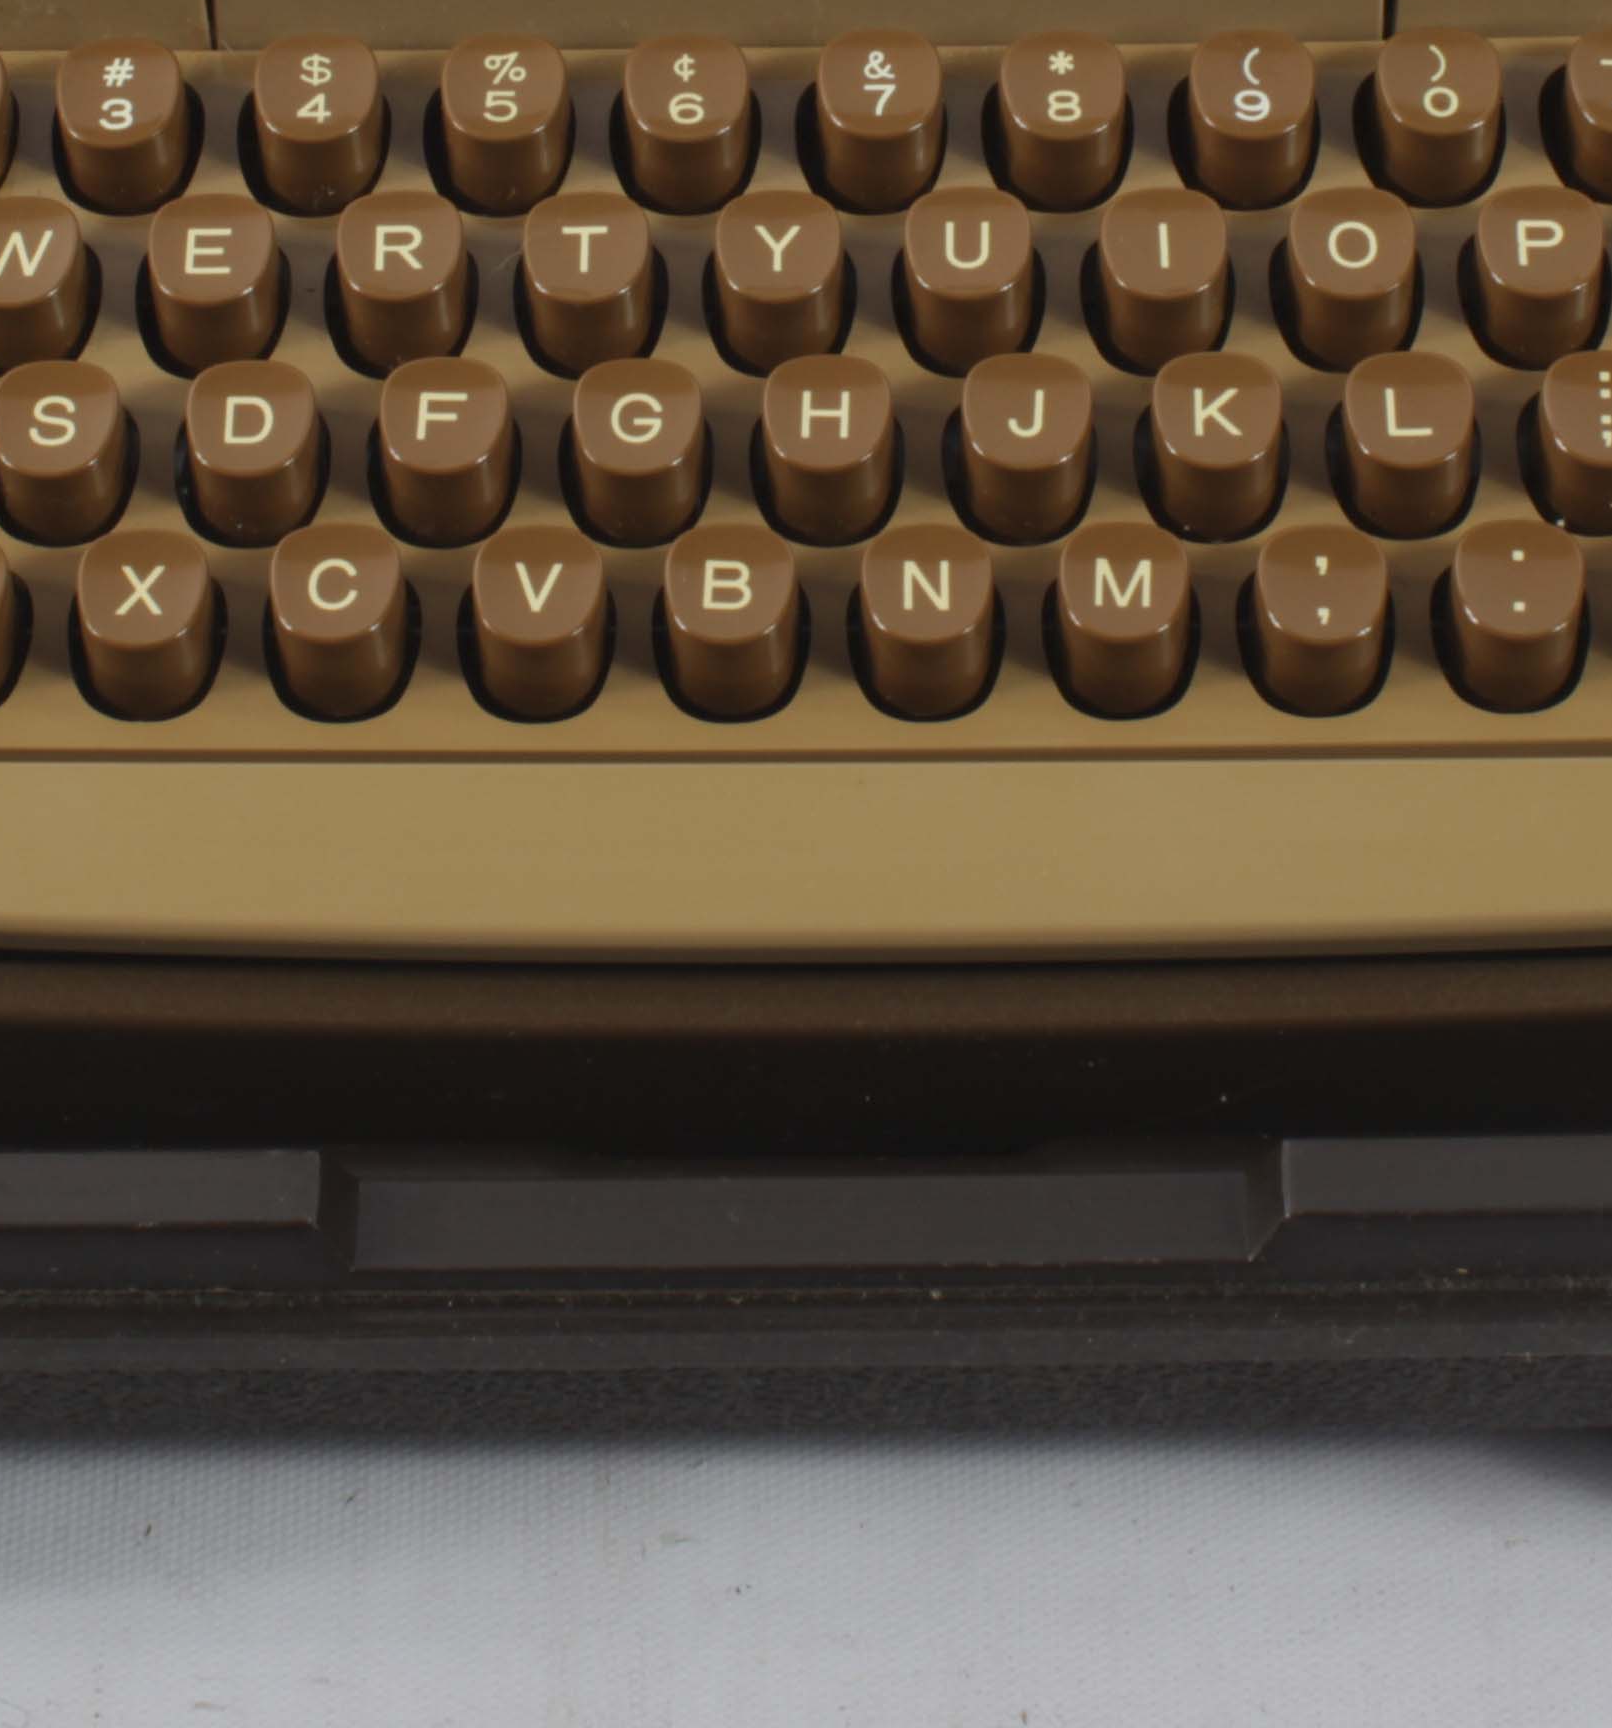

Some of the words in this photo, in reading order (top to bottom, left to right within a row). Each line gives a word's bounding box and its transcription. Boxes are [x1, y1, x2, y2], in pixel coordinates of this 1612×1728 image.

[103, 58, 134, 87] #
[301, 54, 331, 85] $
[484, 52, 526, 83] %
[863, 50, 895, 79] &
[99, 99, 133, 130] 3
[297, 94, 331, 123] 4
[484, 92, 518, 122] 5
[668, 94, 705, 124] 6
[864, 85, 896, 116] 7
[1048, 91, 1081, 122] 8
[1235, 90, 1270, 121] 9
[185, 228, 233, 274] E
[373, 225, 423, 271] R
[562, 226, 608, 272] T
[754, 225, 801, 271] Y
[945, 221, 990, 269] U
[1157, 223, 1169, 269] I
[1328, 222, 1378, 268] O
[1516, 220, 1564, 266] P
[28, 396, 77, 446] S
[223, 395, 275, 444] D
[415, 392, 468, 441] F
[610, 393, 663, 443] G
[799, 390, 851, 439] H
[1008, 389, 1045, 437] J
[1193, 388, 1242, 436] K
[1385, 388, 1433, 437] L
[114, 564, 166, 616] X
[307, 559, 359, 610] C
[515, 563, 563, 612] V
[701, 560, 753, 610] B
[903, 560, 951, 611] N
[1093, 558, 1152, 608] M
